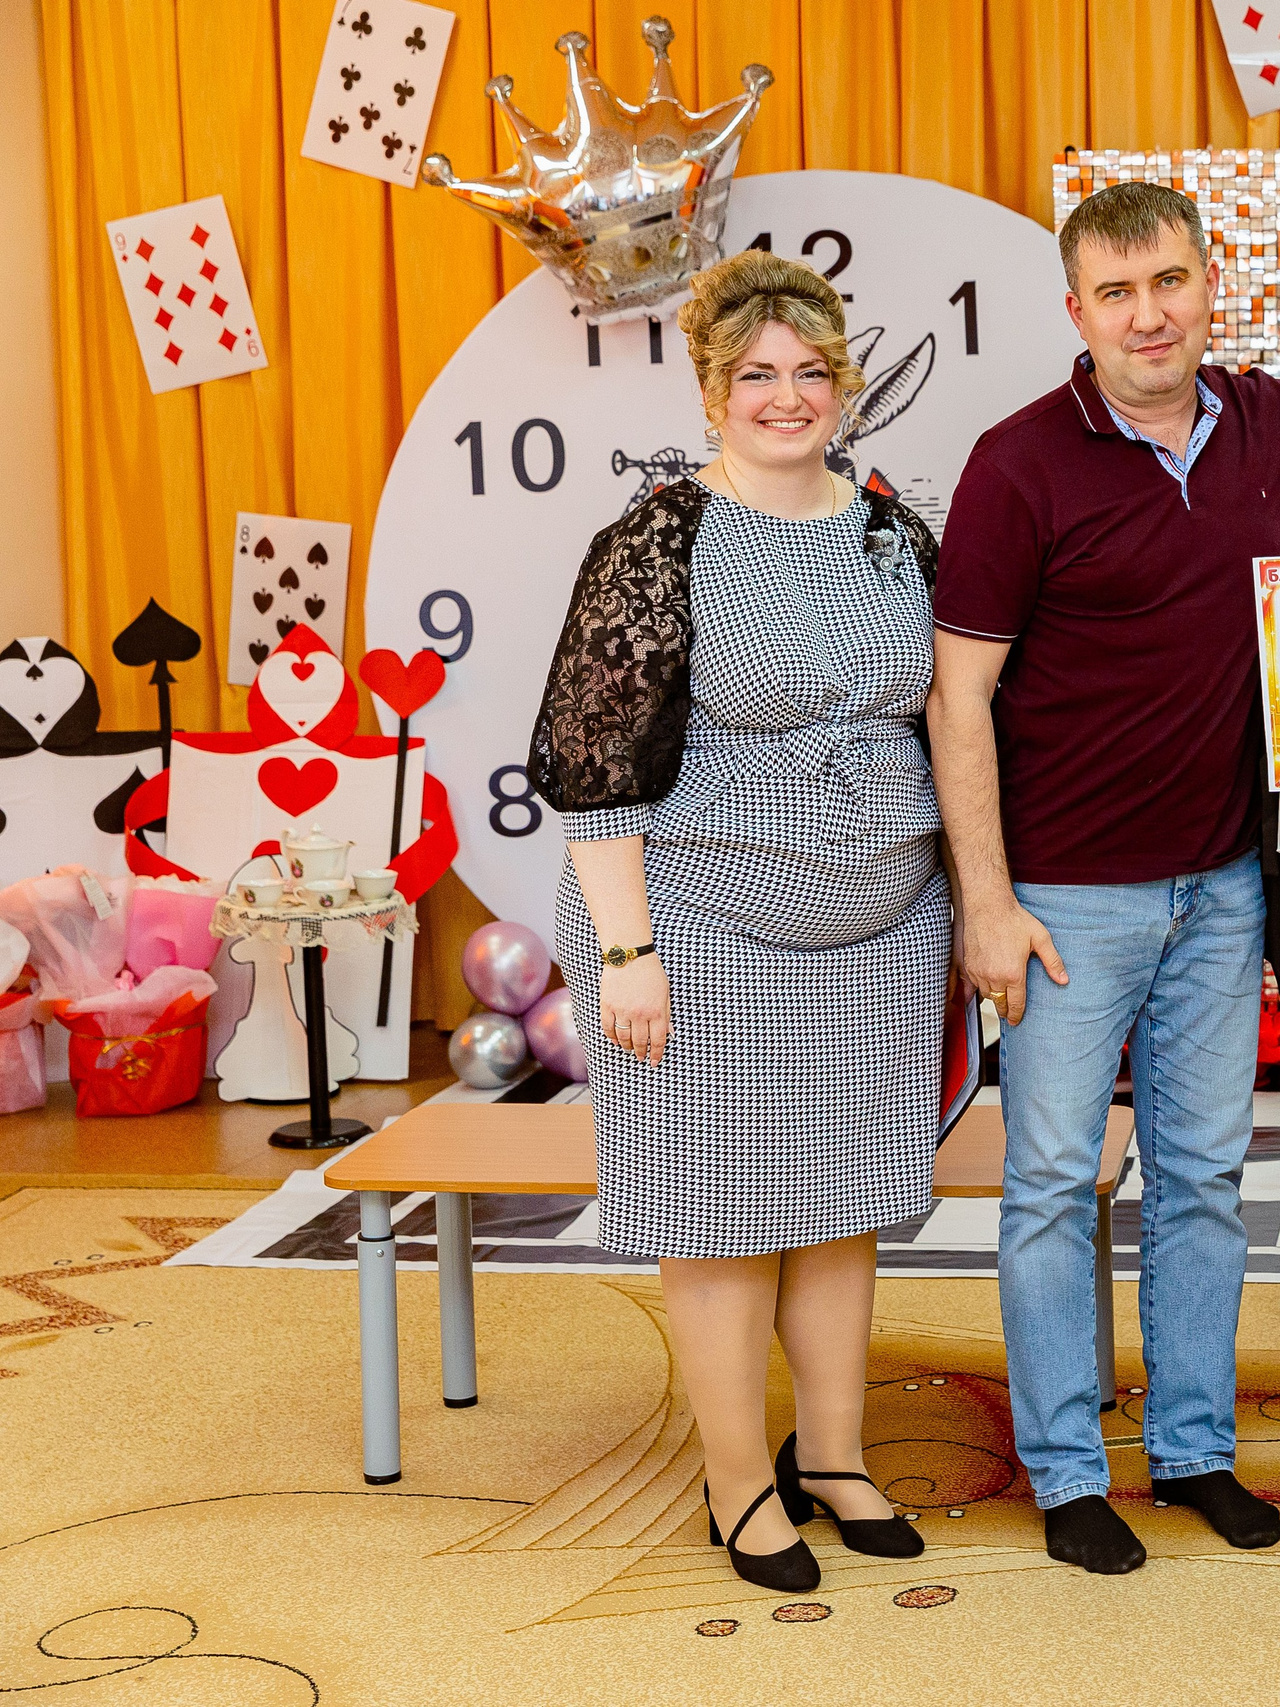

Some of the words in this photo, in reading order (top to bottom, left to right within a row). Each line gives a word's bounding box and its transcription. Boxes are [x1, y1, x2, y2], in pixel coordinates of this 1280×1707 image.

[114, 232, 127, 251] 9
[948, 281, 979, 356] 1
[454, 418, 566, 496] 10
[240, 524, 251, 543] 8
[420, 589, 474, 664] 9
[489, 764, 542, 838] 8
